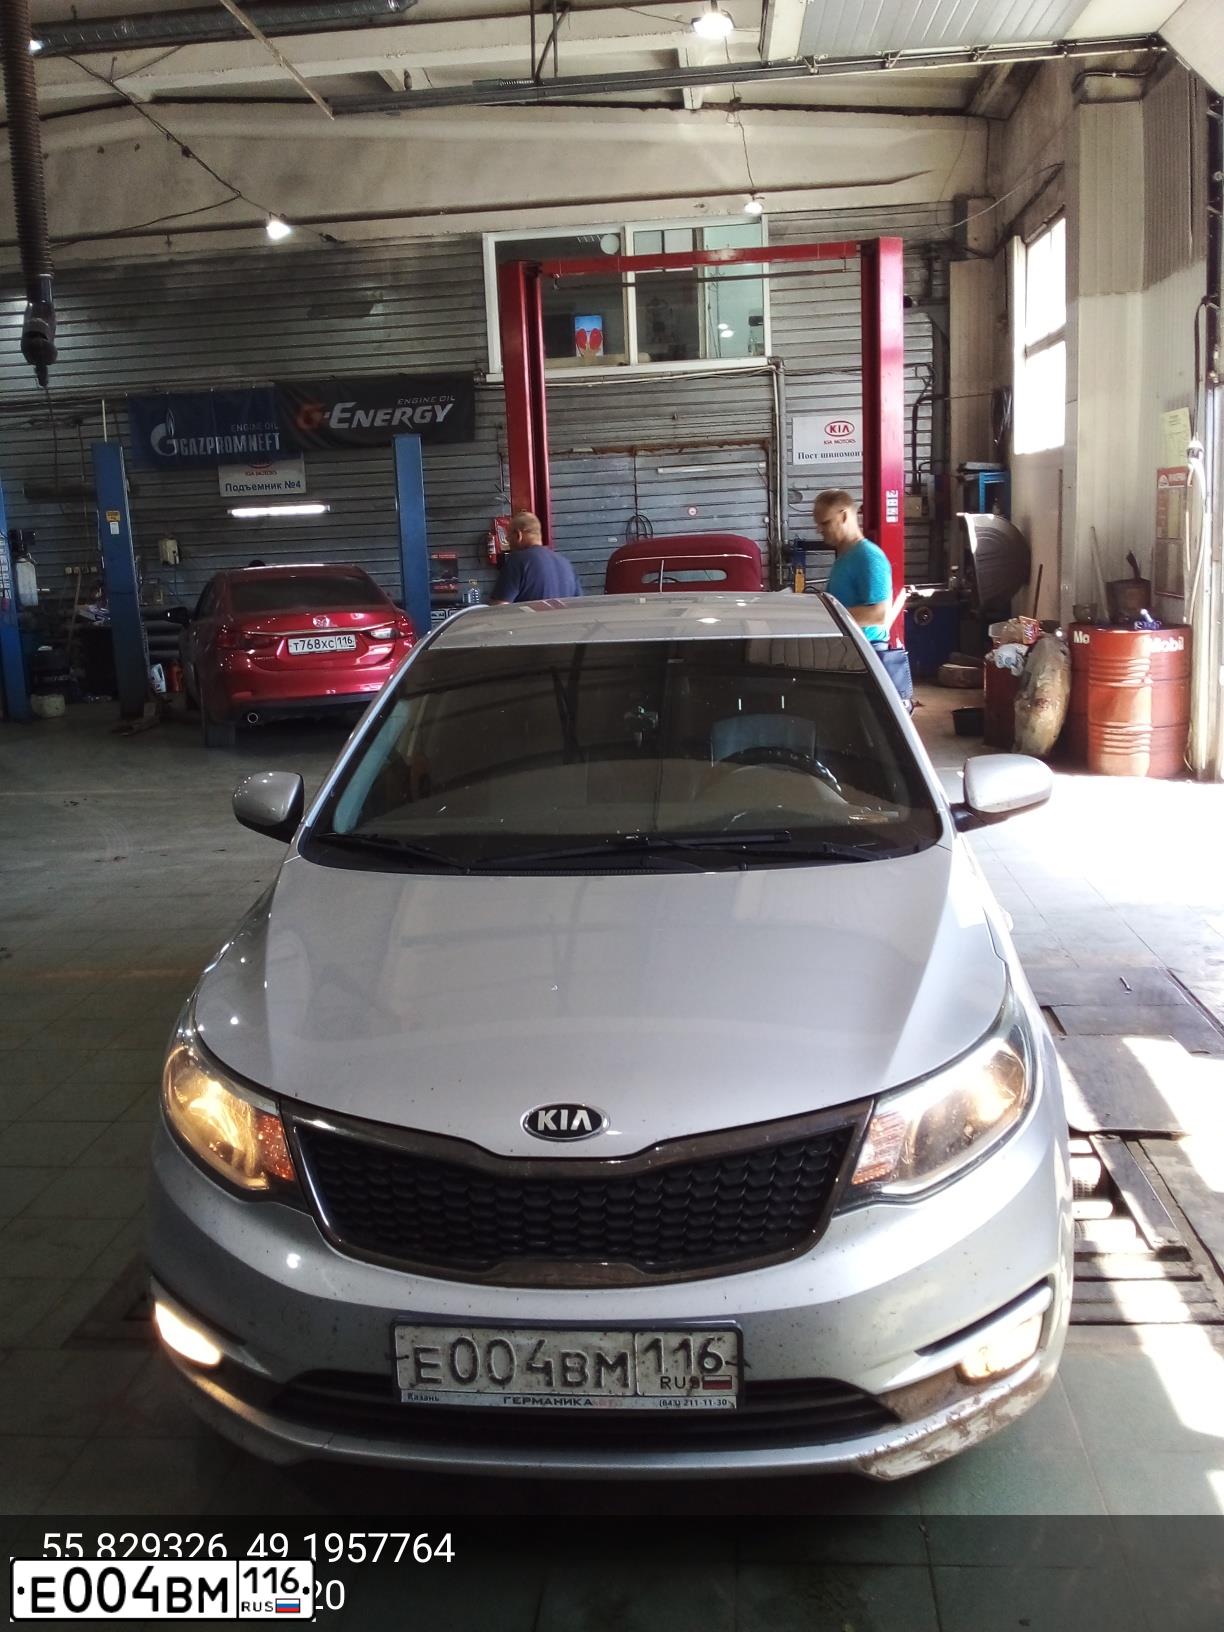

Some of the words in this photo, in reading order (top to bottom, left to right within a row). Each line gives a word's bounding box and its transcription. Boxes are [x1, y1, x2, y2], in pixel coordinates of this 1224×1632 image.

[829, 424, 850, 434] KIA
[180, 432, 280, 456] GAZPROMNEFT
[798, 452, 818, 460] Пост
[820, 451, 863, 459] шиномон
[225, 483, 282, 492] Подъемник
[537, 1109, 592, 1131] KIA
[645, 1335, 724, 1375] 116
